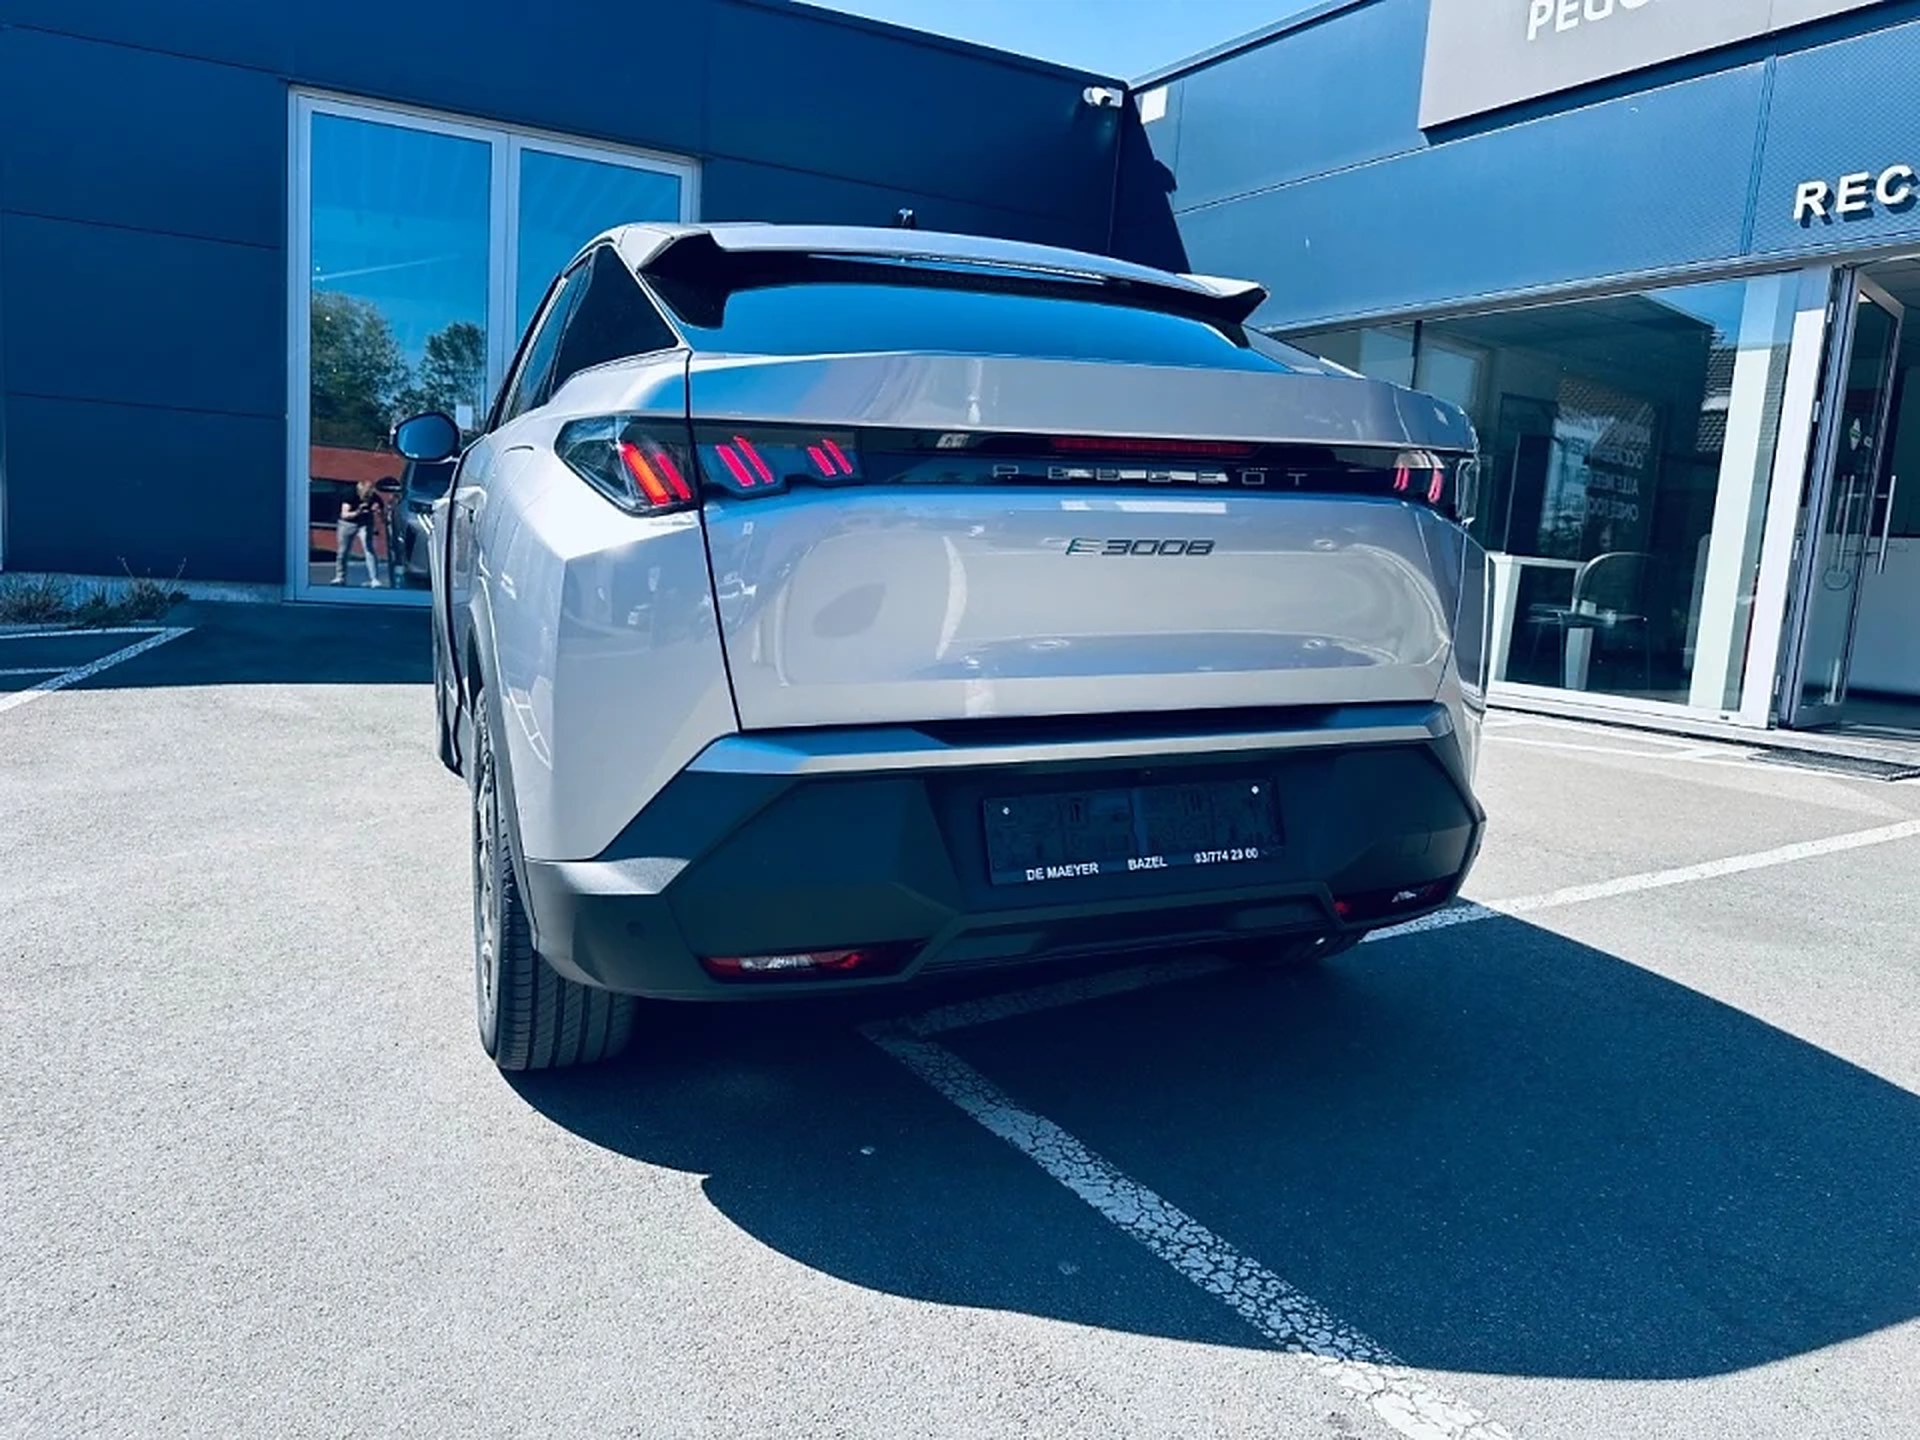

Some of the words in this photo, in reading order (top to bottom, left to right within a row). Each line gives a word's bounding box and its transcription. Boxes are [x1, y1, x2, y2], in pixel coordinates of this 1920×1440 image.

[1526, 0, 1652, 41] PEU
[1793, 164, 1914, 221] REC
[1026, 868, 1044, 881] DE
[1047, 863, 1099, 880] MAEYER
[1127, 856, 1168, 871] BAZEL
